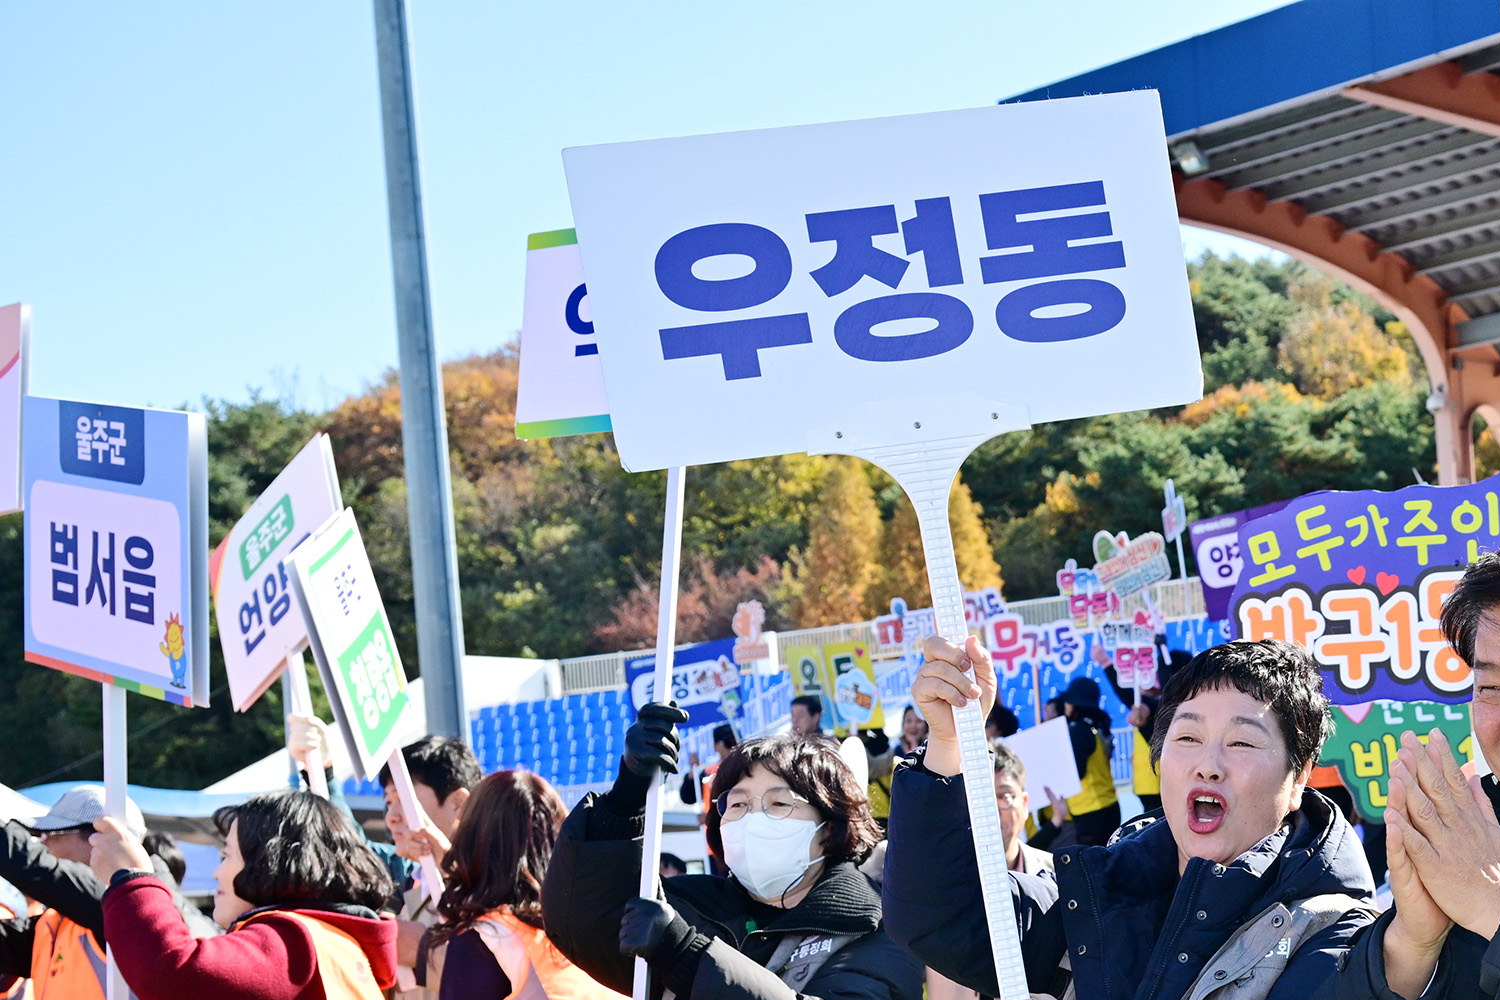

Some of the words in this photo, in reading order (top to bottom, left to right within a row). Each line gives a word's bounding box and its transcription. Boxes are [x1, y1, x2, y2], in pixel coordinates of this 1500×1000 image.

[654, 180, 1126, 380] 우정동
[75, 415, 127, 466] 울주군
[245, 503, 288, 571] 울주군
[50, 521, 156, 625] 범서읍
[992, 620, 1079, 671] 무거동
